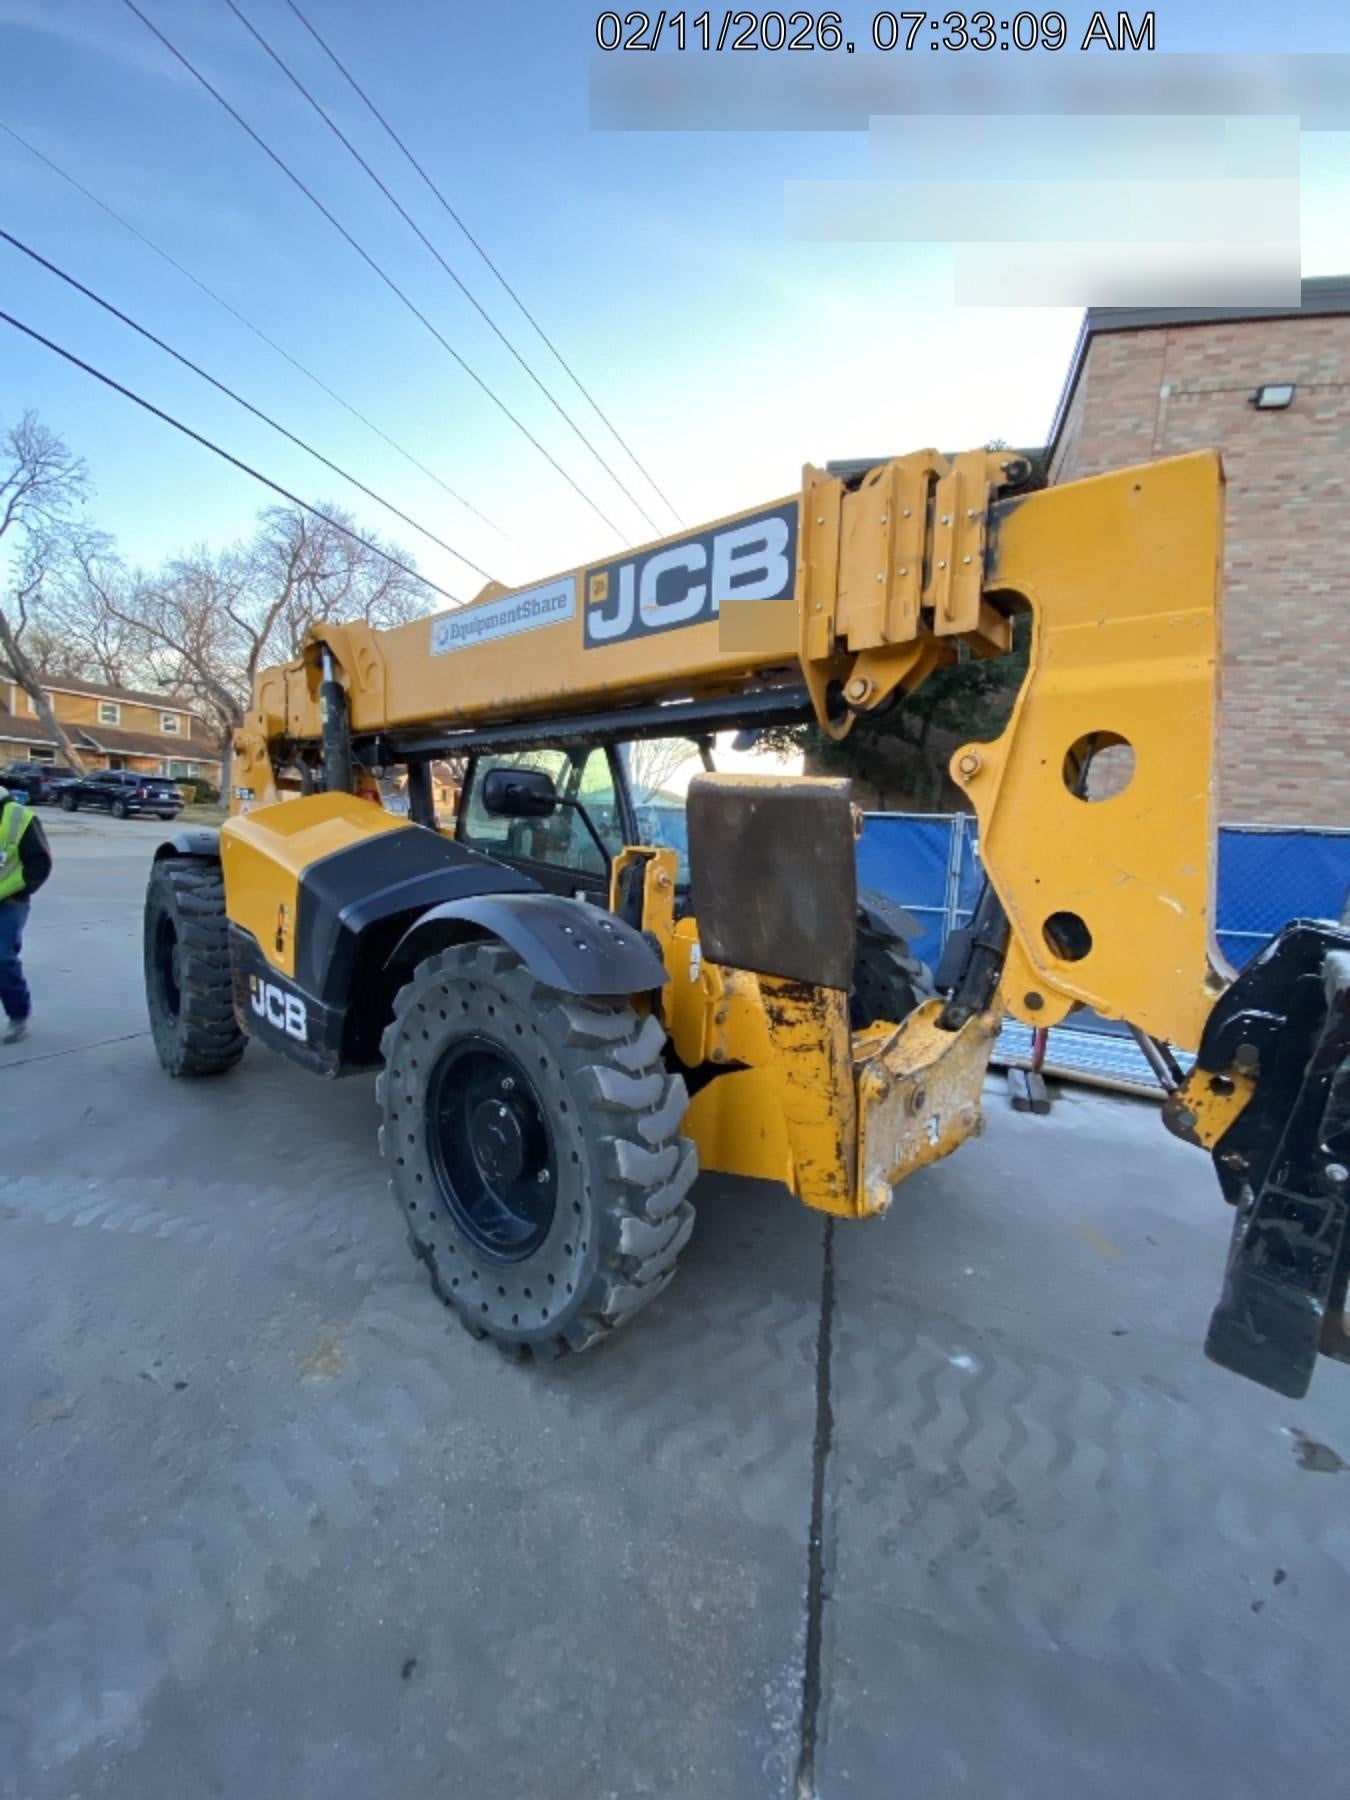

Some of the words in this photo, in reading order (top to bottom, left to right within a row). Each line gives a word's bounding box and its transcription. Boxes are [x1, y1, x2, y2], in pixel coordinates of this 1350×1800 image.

[588, 517, 788, 639] JCB
[450, 593, 567, 640] EquipmentShare
[251, 978, 307, 1041] JCB
